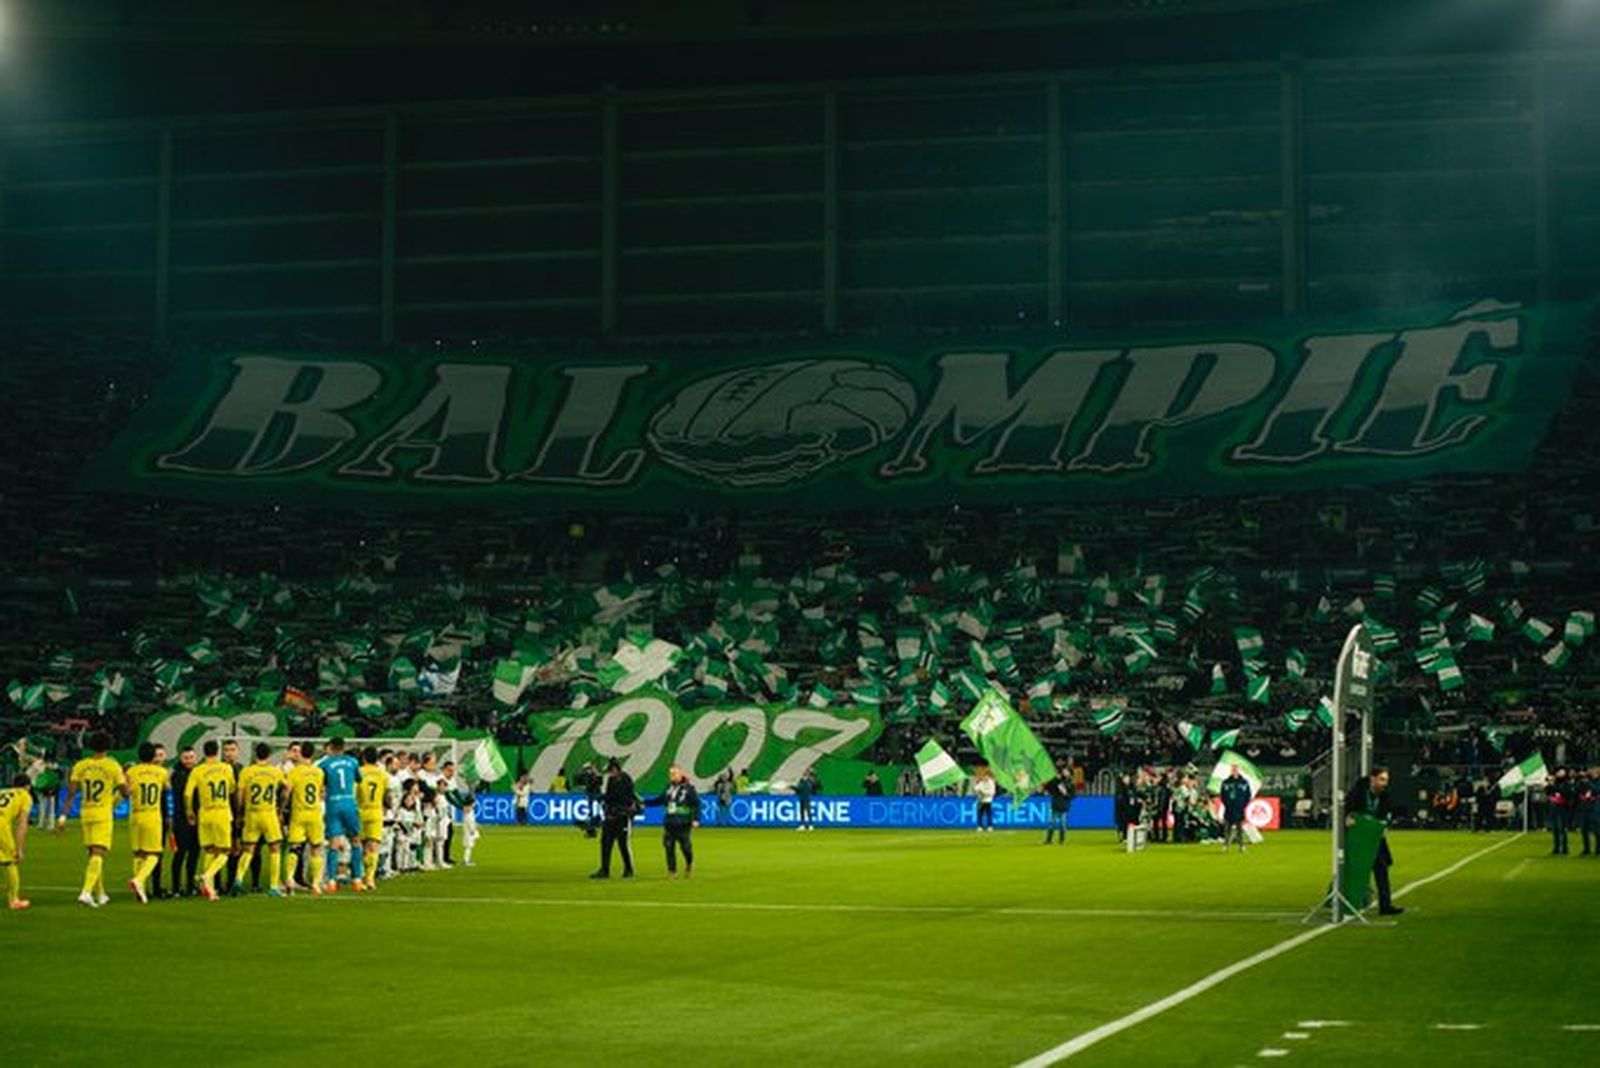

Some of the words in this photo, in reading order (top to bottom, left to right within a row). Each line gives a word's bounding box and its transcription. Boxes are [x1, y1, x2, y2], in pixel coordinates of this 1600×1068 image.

[528, 699, 870, 794] 1907
[338, 768, 347, 789] 1
[85, 779, 105, 802] 12
[140, 783, 159, 806] 10
[208, 780, 227, 802] 14
[250, 783, 274, 805] 24
[304, 783, 317, 805] 8
[368, 781, 378, 802] 7
